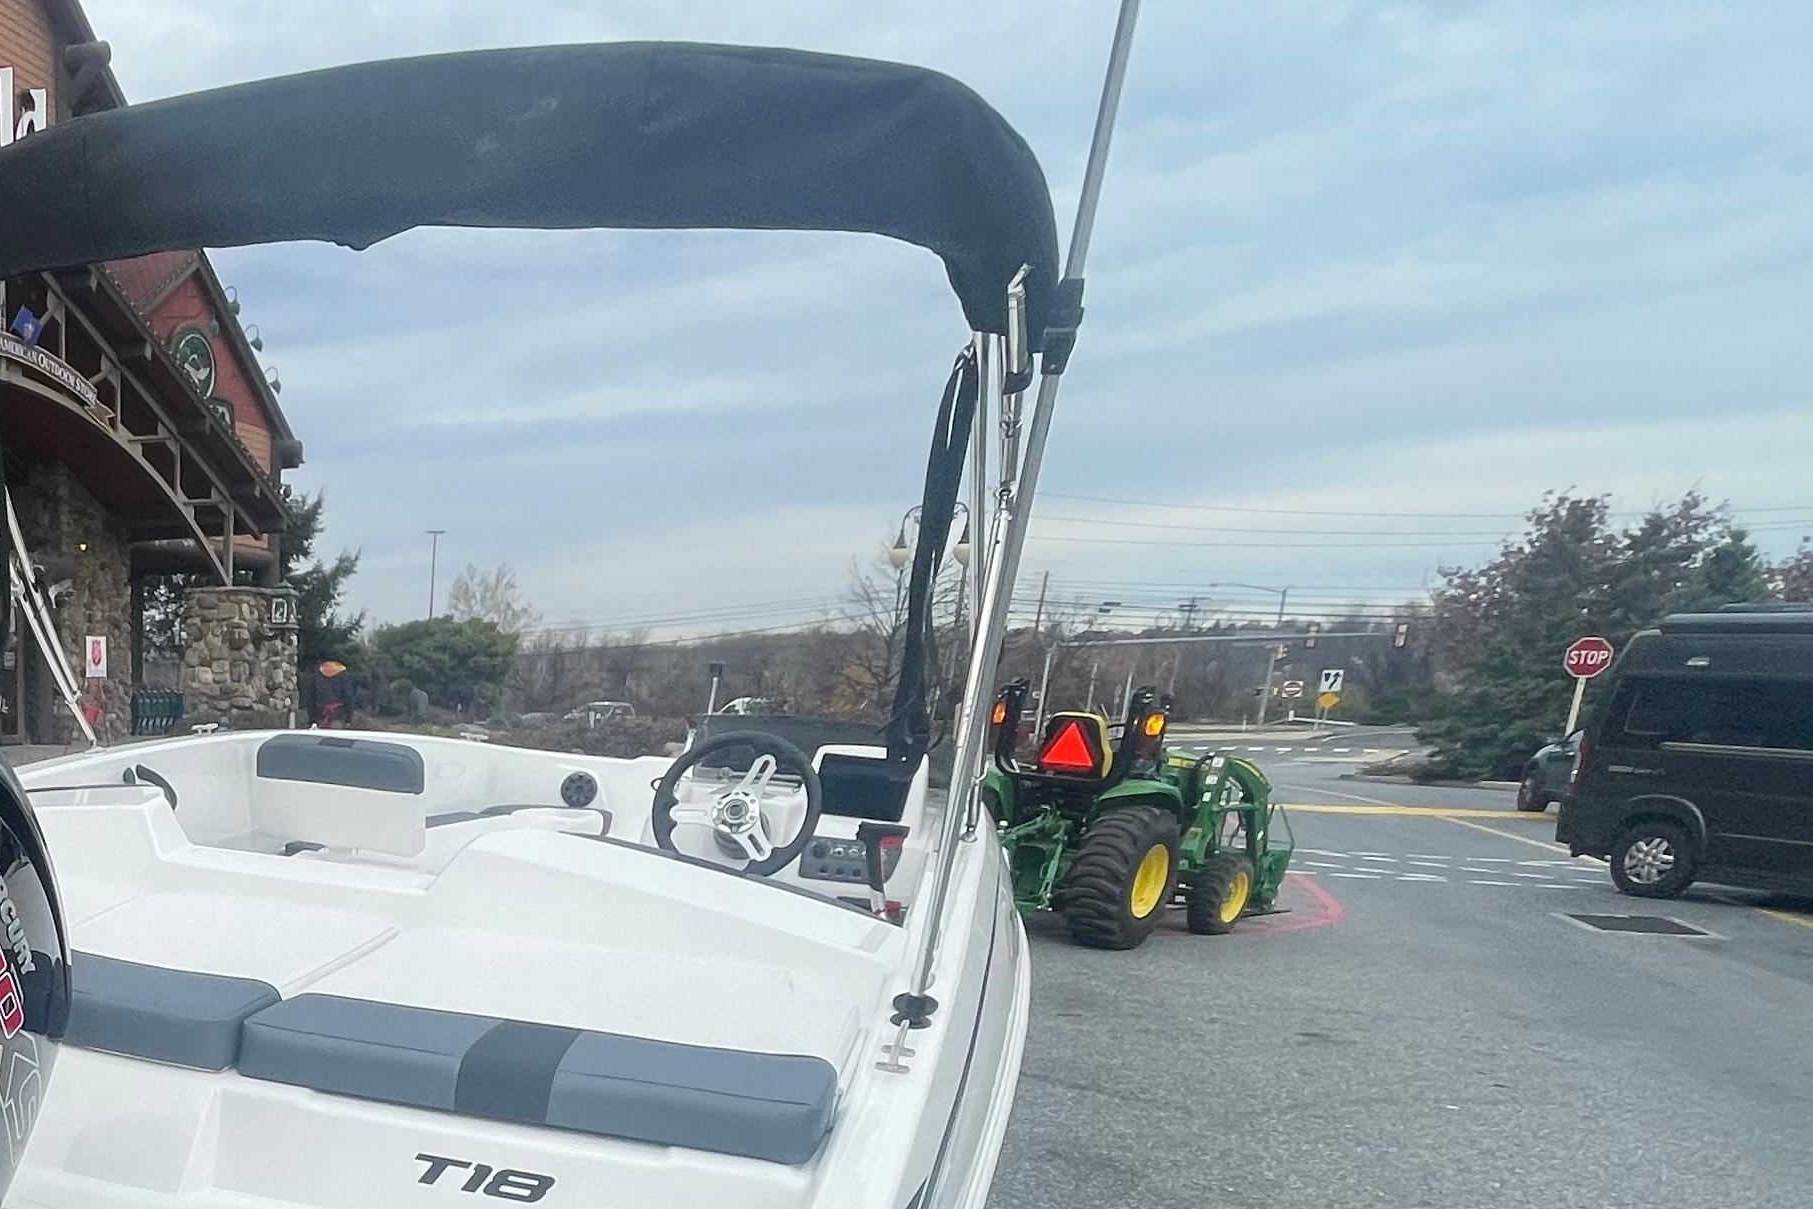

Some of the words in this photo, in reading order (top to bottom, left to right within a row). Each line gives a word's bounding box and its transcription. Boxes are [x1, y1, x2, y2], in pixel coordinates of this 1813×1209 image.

[38, 353, 76, 388] OUTDOOR
[1568, 650, 1609, 665] STOP
[414, 1152, 556, 1203] T18
